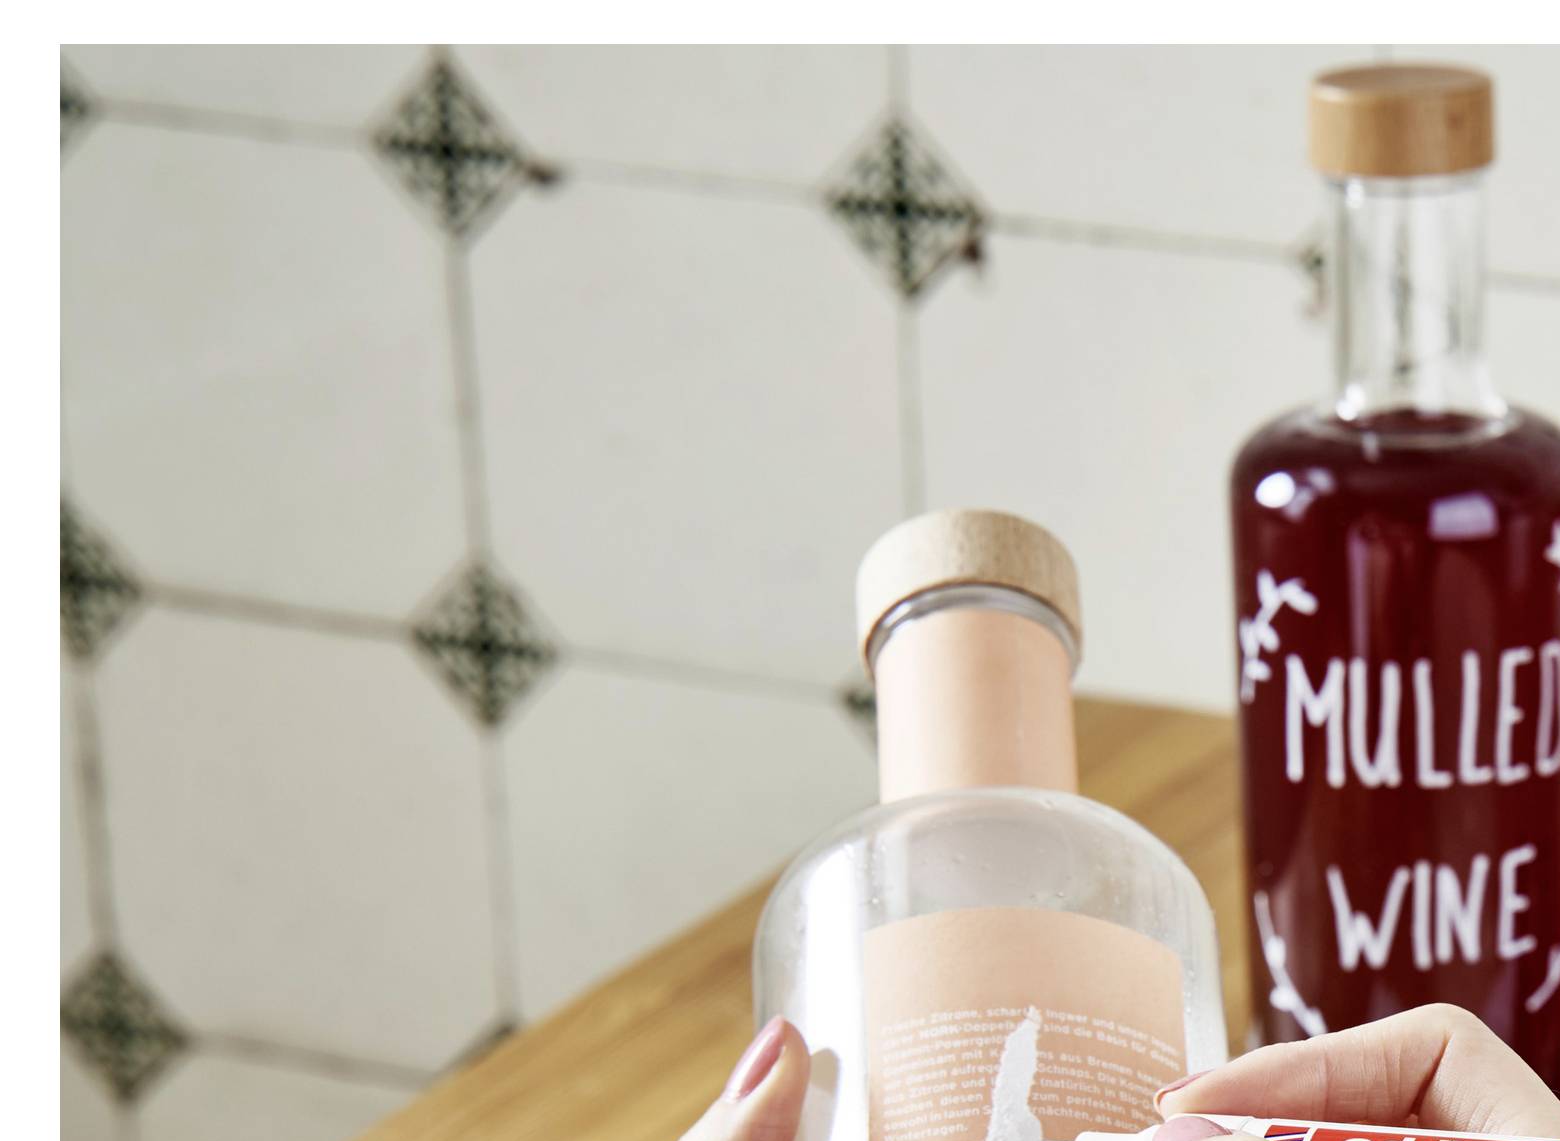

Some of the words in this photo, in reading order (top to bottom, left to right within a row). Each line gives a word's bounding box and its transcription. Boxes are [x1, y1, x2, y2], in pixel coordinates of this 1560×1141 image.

[1326, 843, 1537, 973] WINE
[1043, 1023, 1070, 1035] sind
[1073, 1026, 1093, 1038] die
[1092, 1018, 1115, 1031] und
[961, 1049, 983, 1061] mit
[960, 1077, 986, 1089] und
[940, 1093, 984, 1107] diesen
[1032, 1092, 1060, 1103] zum
[930, 1112, 942, 1123] in
[943, 1107, 980, 1120] lauen
